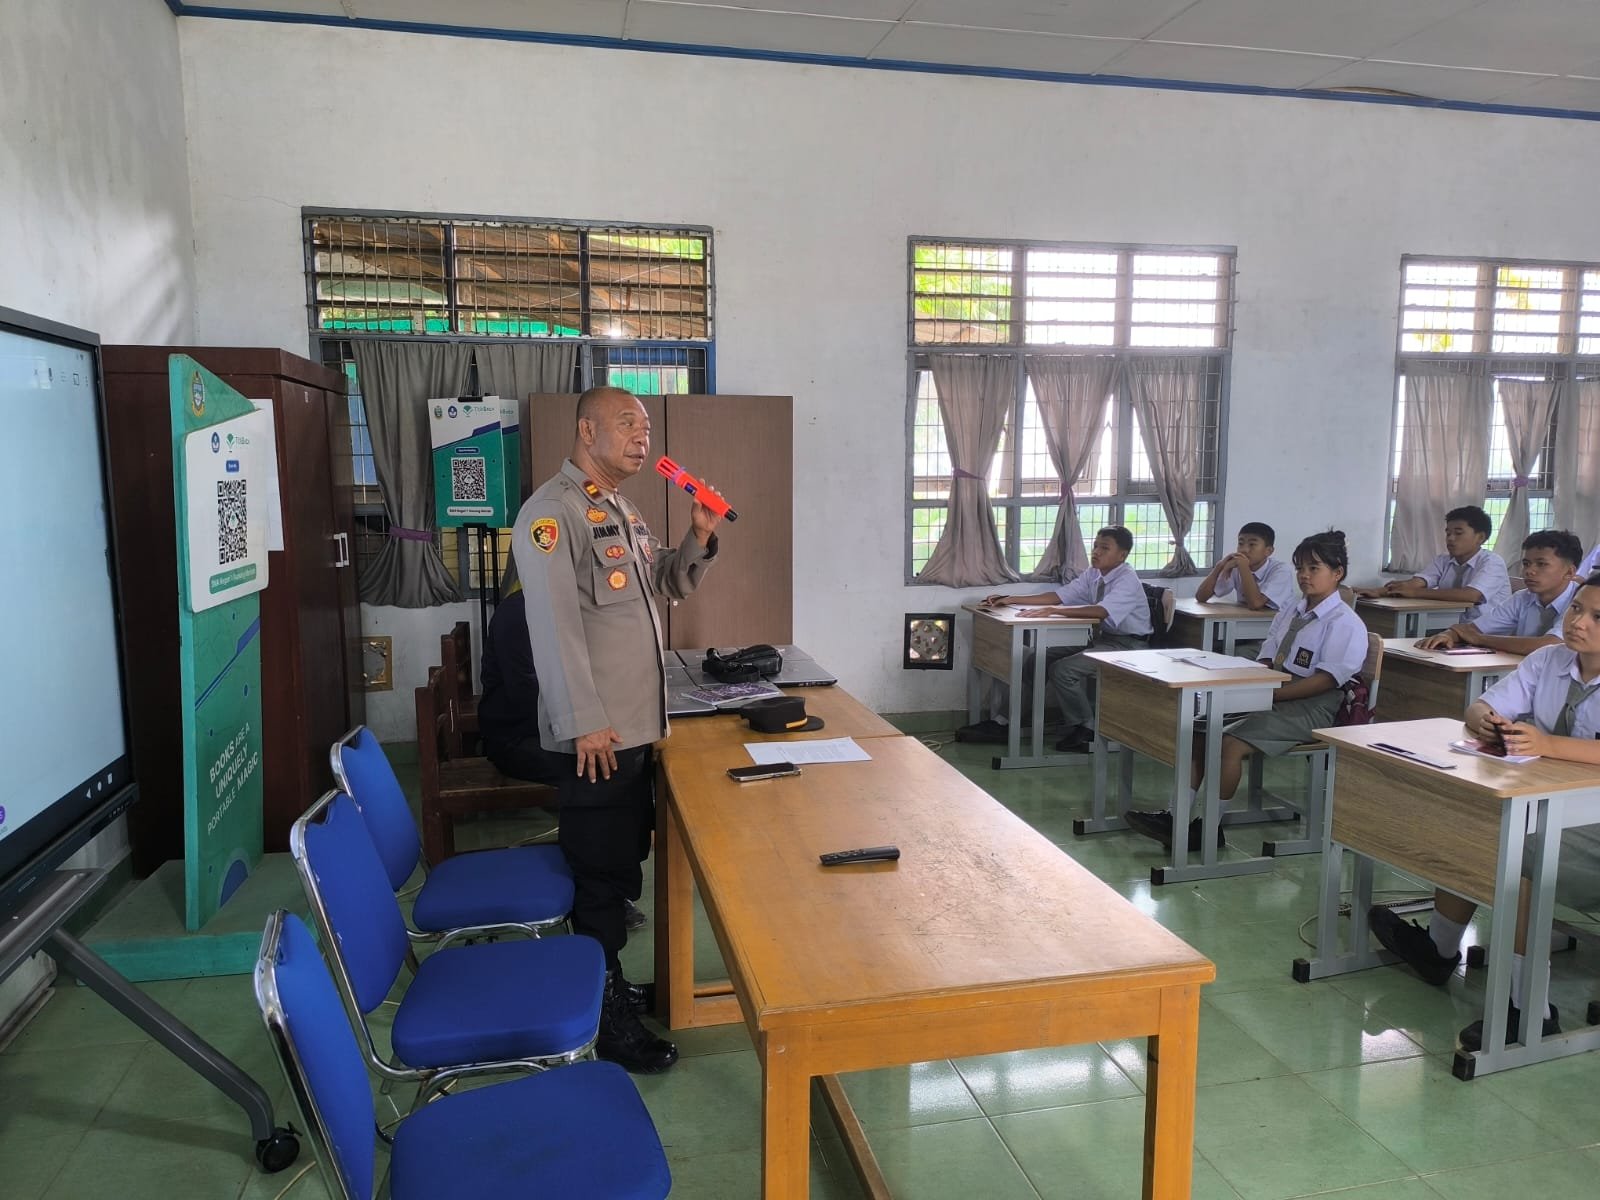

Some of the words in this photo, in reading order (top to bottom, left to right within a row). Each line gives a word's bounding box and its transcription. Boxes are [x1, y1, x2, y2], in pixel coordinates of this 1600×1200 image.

[593, 524, 620, 539] JIMMY
[209, 740, 235, 783] BOOKS
[235, 728, 245, 749] ARE
[245, 722, 250, 735] A
[215, 743, 248, 799] UNIQUELY
[207, 786, 236, 836] PORTABLE
[236, 751, 259, 791] MAGIC
